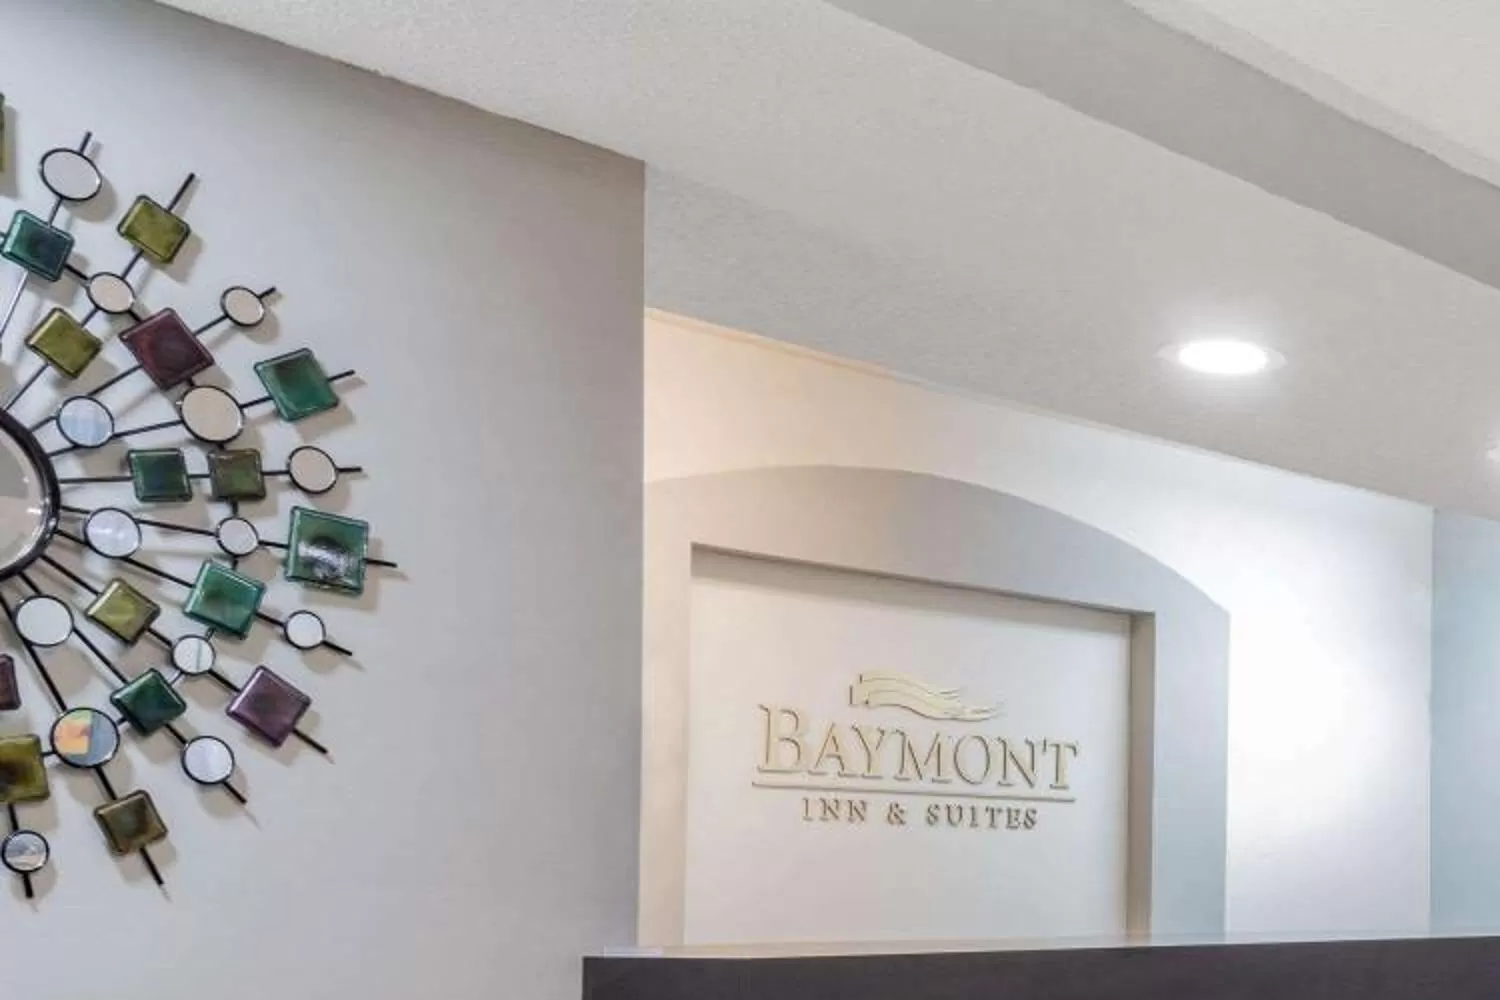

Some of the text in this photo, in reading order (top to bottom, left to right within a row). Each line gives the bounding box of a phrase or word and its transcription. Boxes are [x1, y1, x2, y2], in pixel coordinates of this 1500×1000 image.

[757, 703, 1079, 791] BAYMONT
[803, 797, 1038, 830] INN & SUITES
